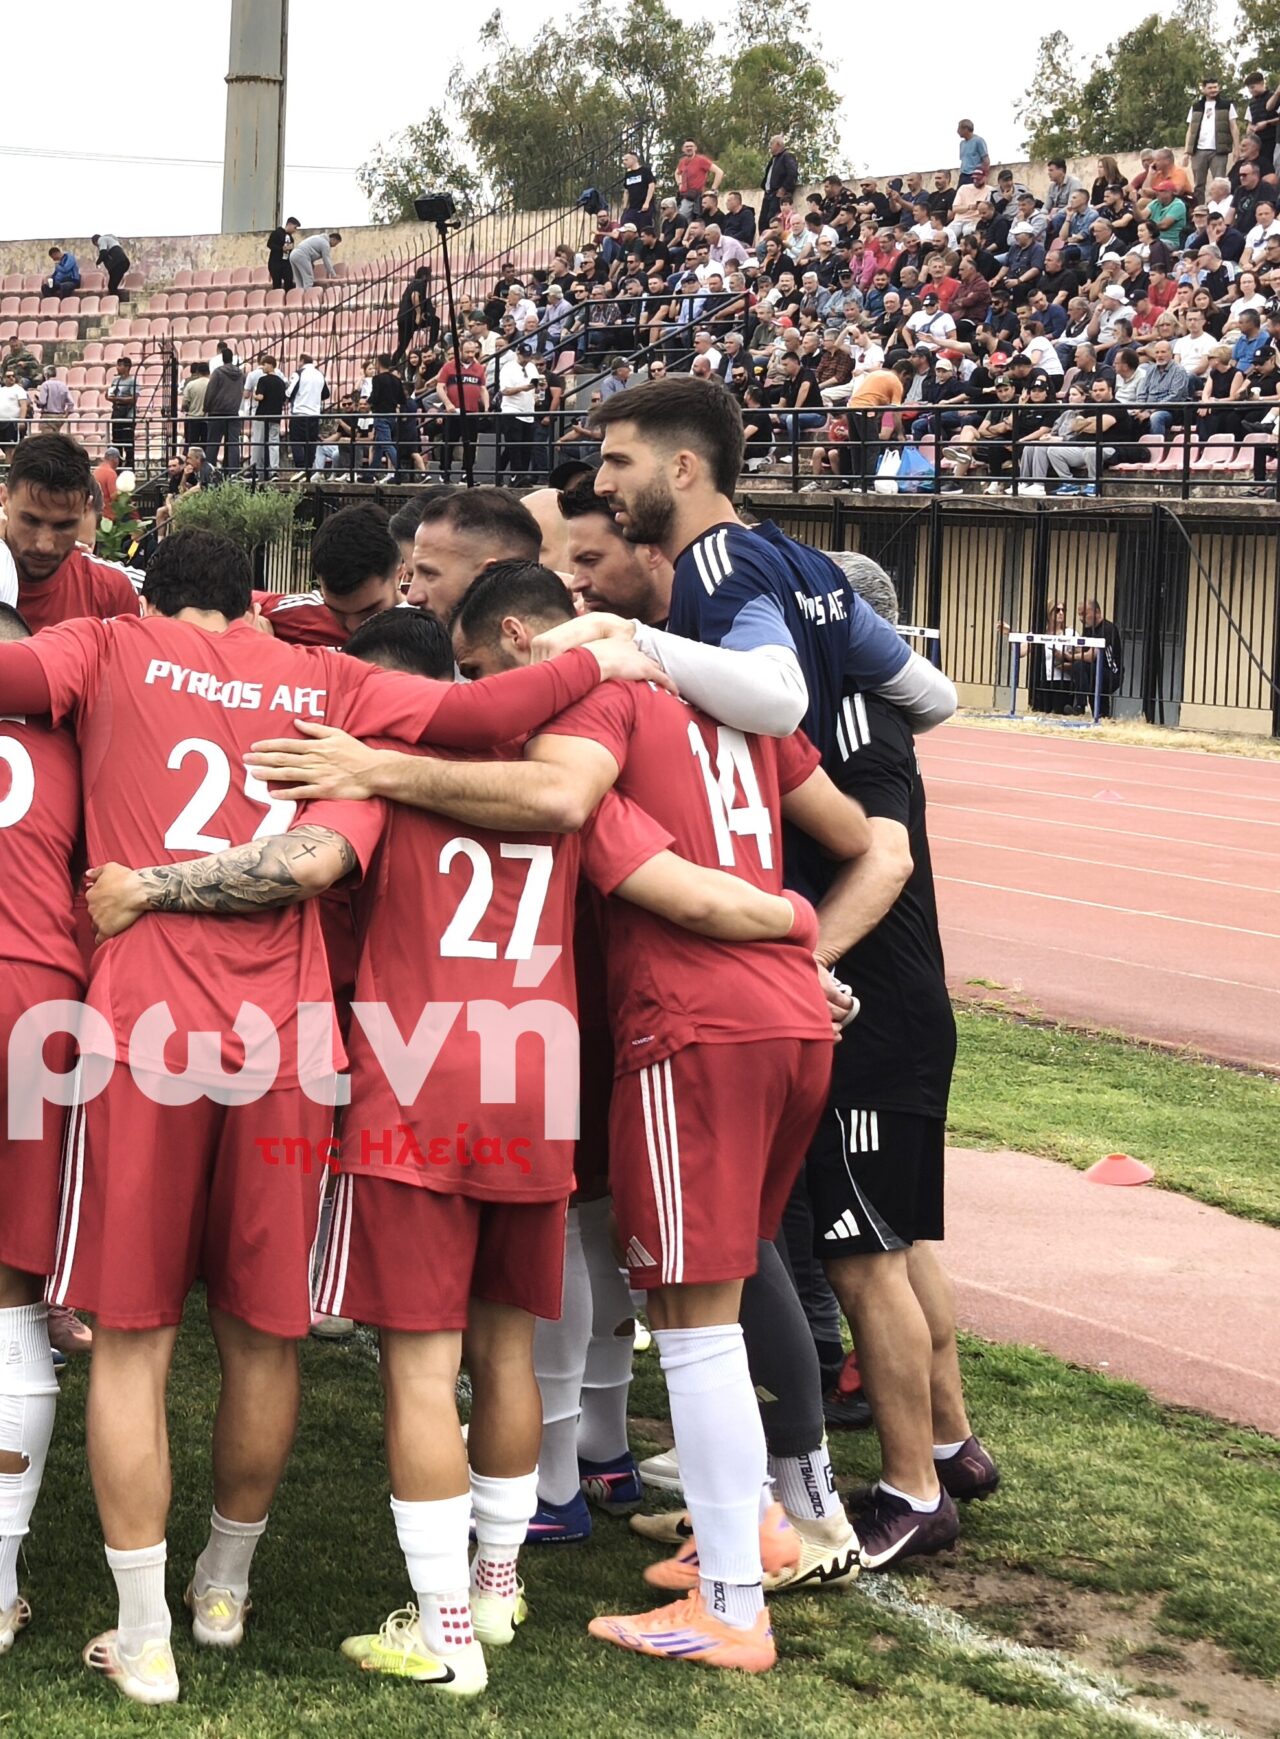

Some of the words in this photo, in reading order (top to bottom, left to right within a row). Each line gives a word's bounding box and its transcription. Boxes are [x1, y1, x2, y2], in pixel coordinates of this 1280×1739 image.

[269, 684, 327, 717] AFC
[687, 719, 774, 870] 14
[438, 837, 554, 960] 27
